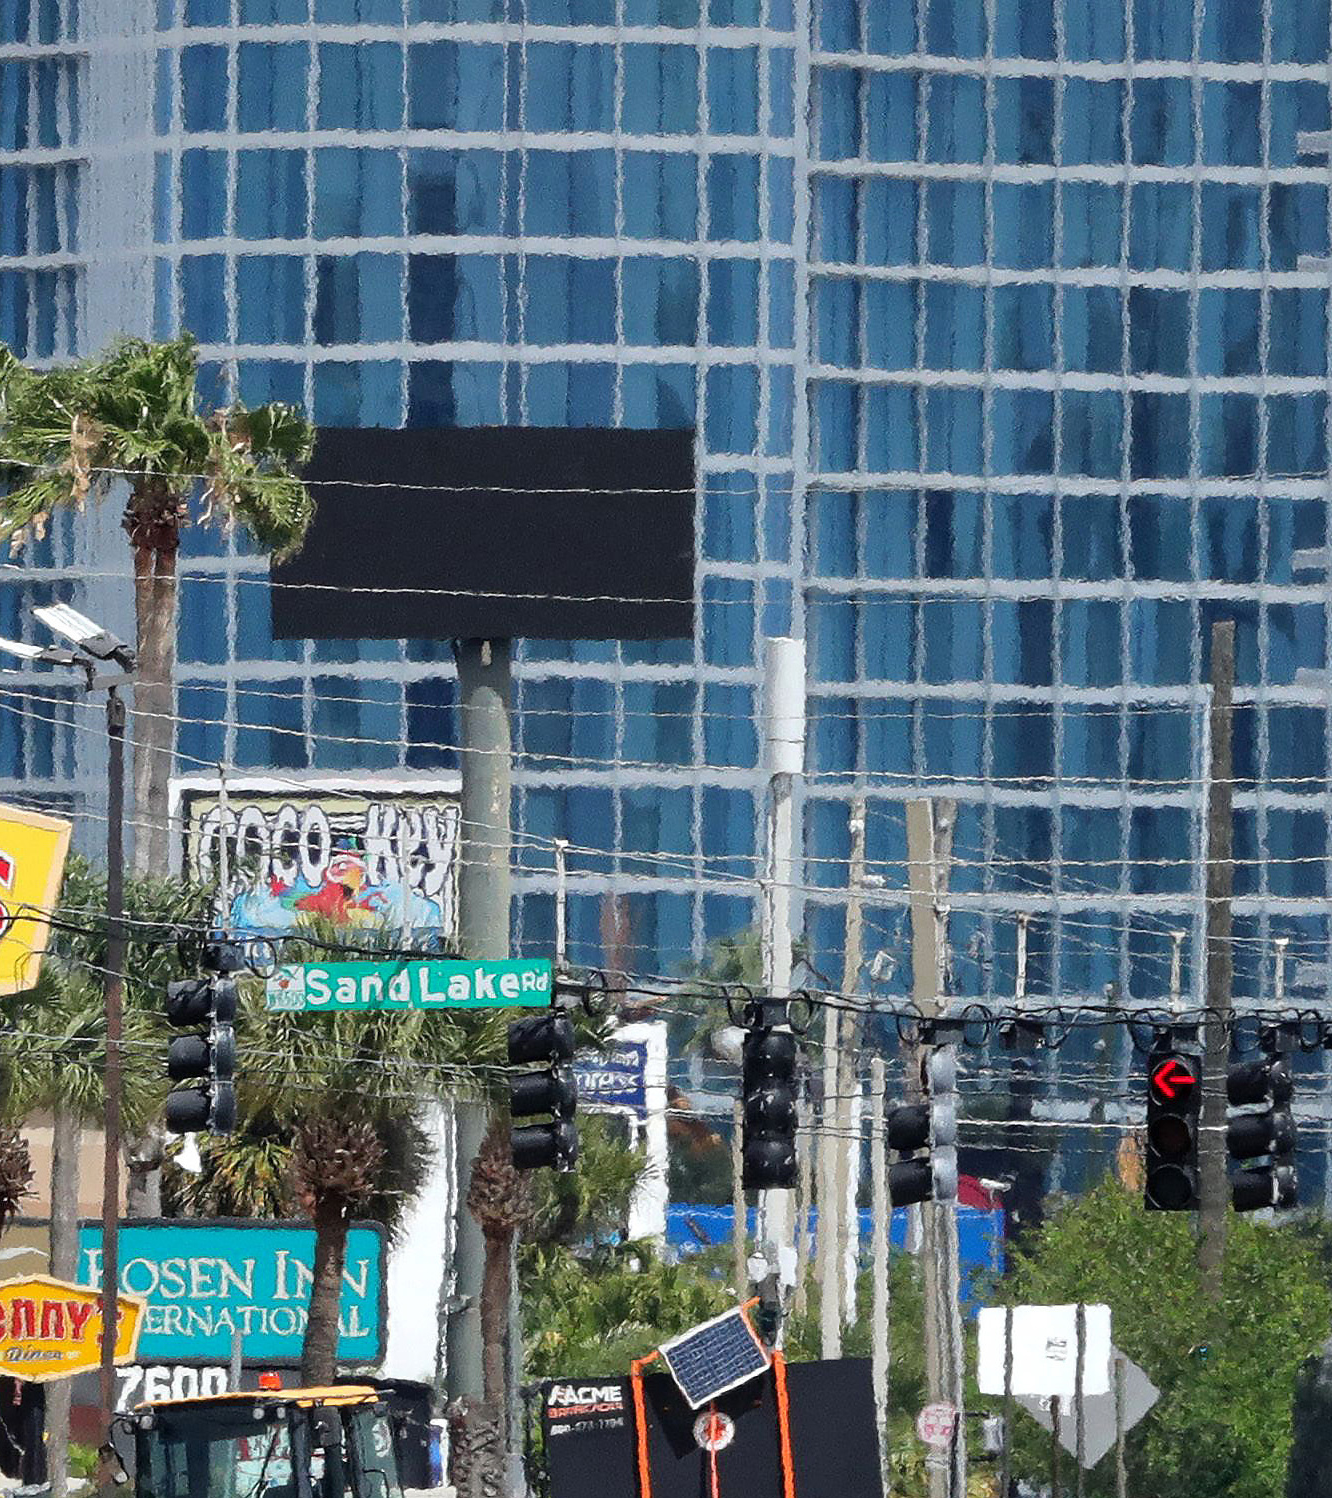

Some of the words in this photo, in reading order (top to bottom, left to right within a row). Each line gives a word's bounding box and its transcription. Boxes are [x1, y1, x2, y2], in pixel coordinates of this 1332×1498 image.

[306, 967, 412, 1005] Sand
[418, 965, 520, 1004] Lake
[520, 970, 551, 993] Rd
[116, 1364, 228, 1412] 7600
